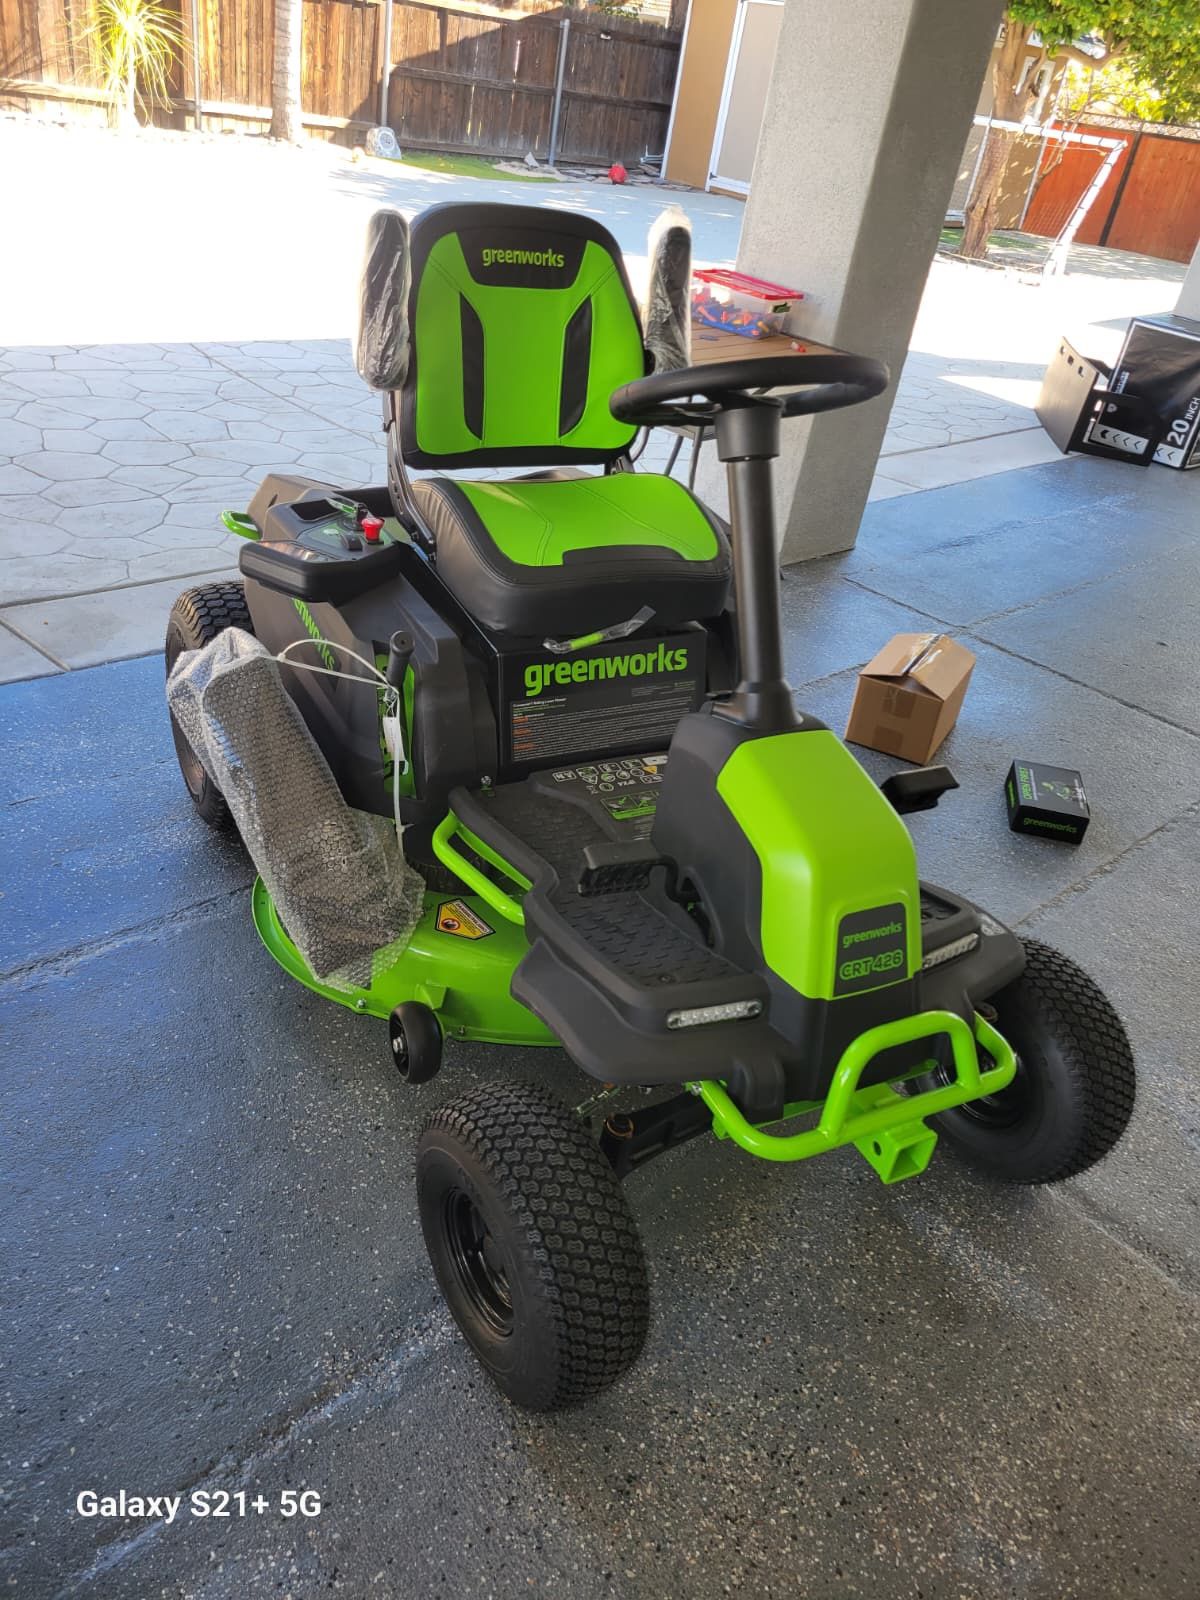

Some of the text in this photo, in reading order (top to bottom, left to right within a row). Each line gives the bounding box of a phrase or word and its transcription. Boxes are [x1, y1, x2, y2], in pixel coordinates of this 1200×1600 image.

[482, 248, 565, 268] greenworks
[1167, 397, 1200, 446] 20 INCH
[524, 643, 688, 697] greenworks
[1023, 817, 1077, 833] greenworks
[842, 921, 903, 949] greenworks
